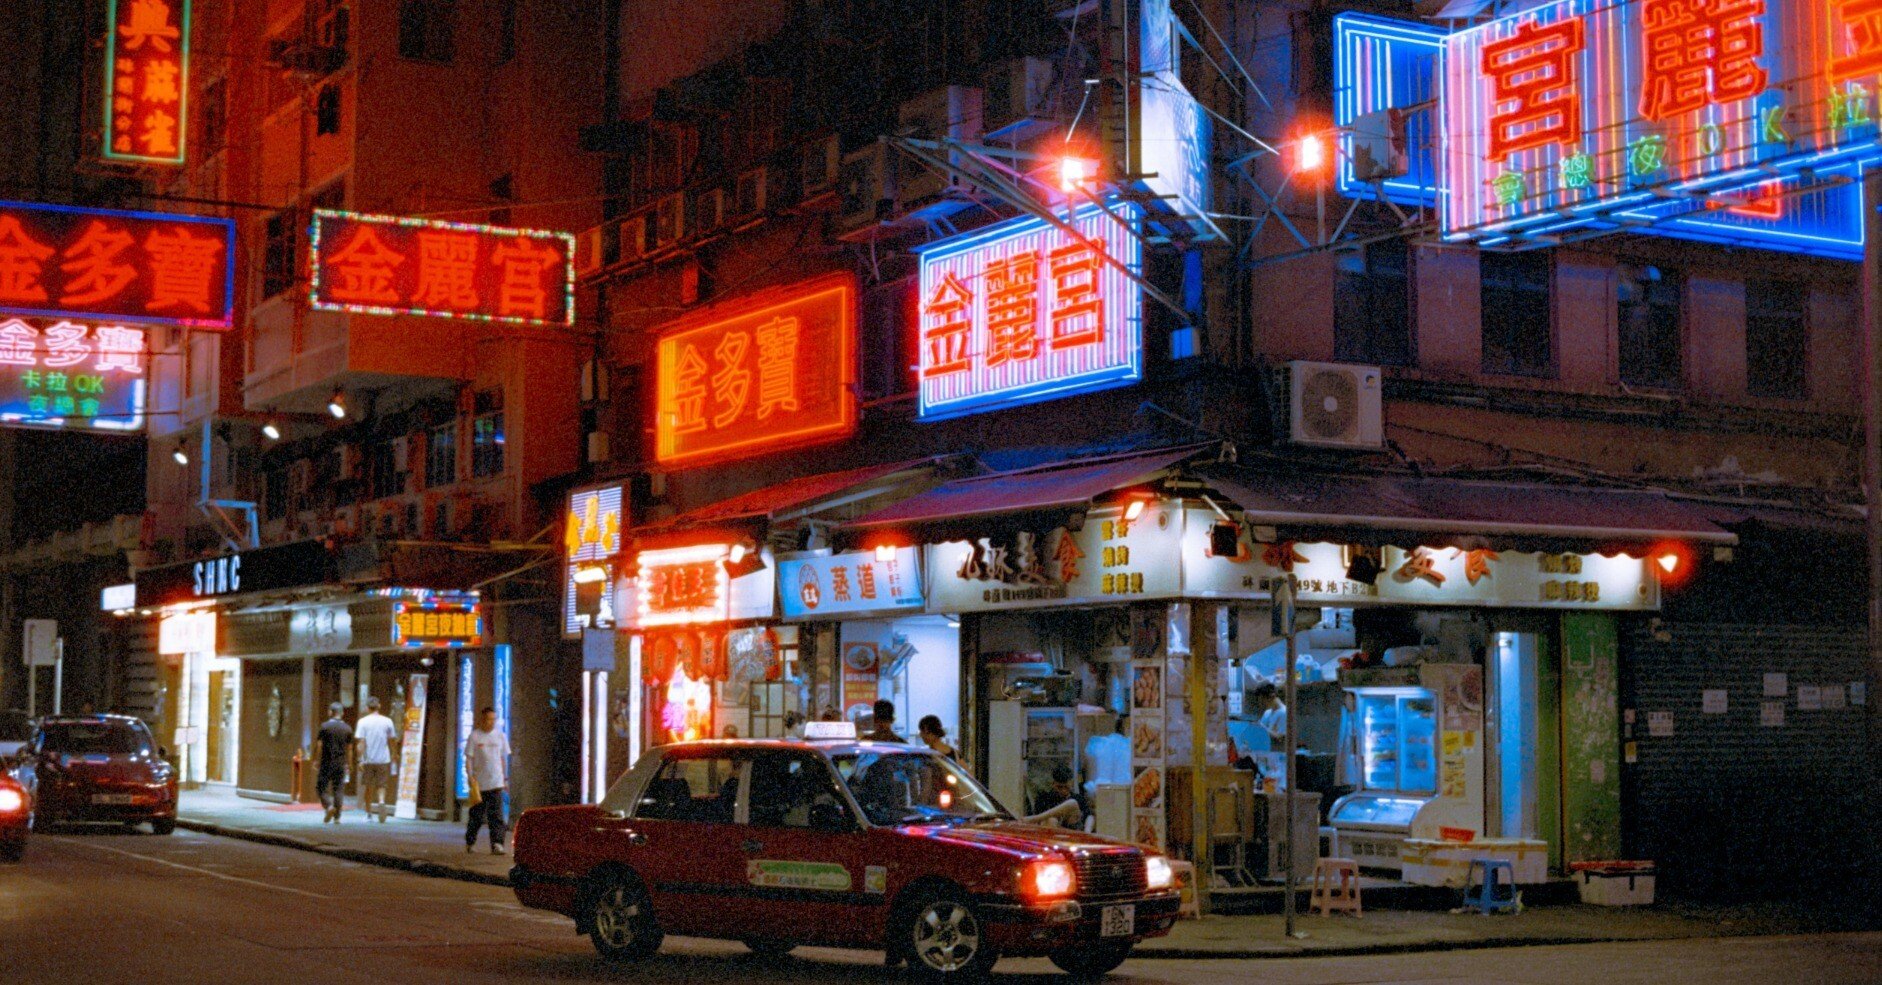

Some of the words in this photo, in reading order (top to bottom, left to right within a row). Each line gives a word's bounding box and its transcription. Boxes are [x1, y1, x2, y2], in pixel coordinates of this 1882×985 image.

[0, 213, 224, 312] 金多寶
[327, 224, 559, 318] 金麗宮
[922, 236, 1106, 378] 金麗宮
[0, 319, 144, 373] 金多寶
[21, 370, 105, 394] 卡拉OK
[670, 315, 799, 435] 金多寶
